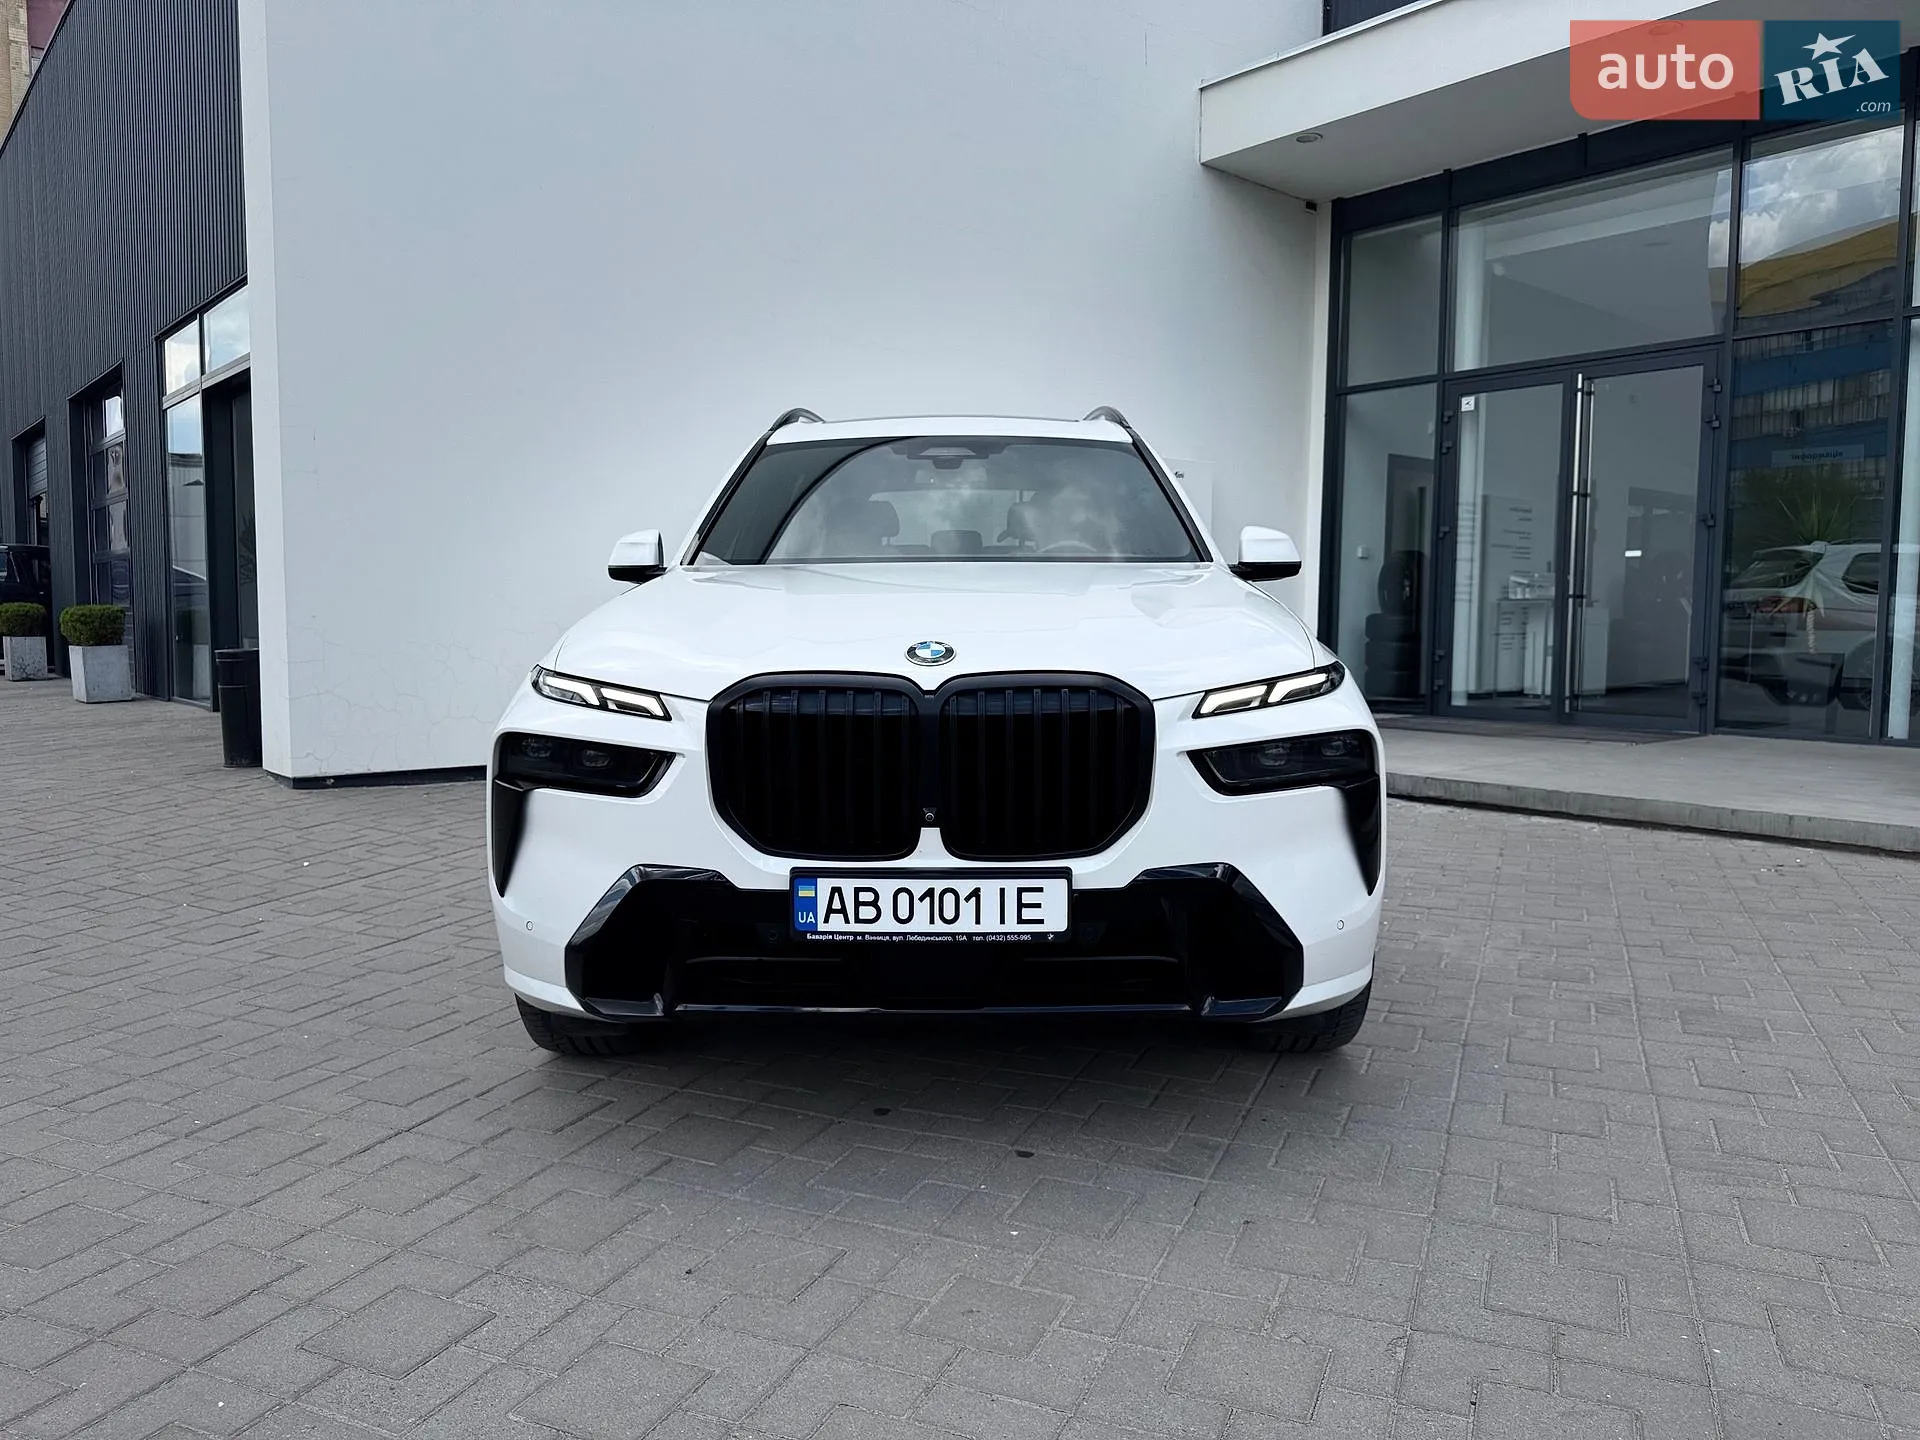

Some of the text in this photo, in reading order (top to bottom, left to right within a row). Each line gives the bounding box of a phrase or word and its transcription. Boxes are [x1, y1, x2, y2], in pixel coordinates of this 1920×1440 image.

[798, 911, 816, 924] UA
[822, 886, 1045, 925] AB 0101 IE
